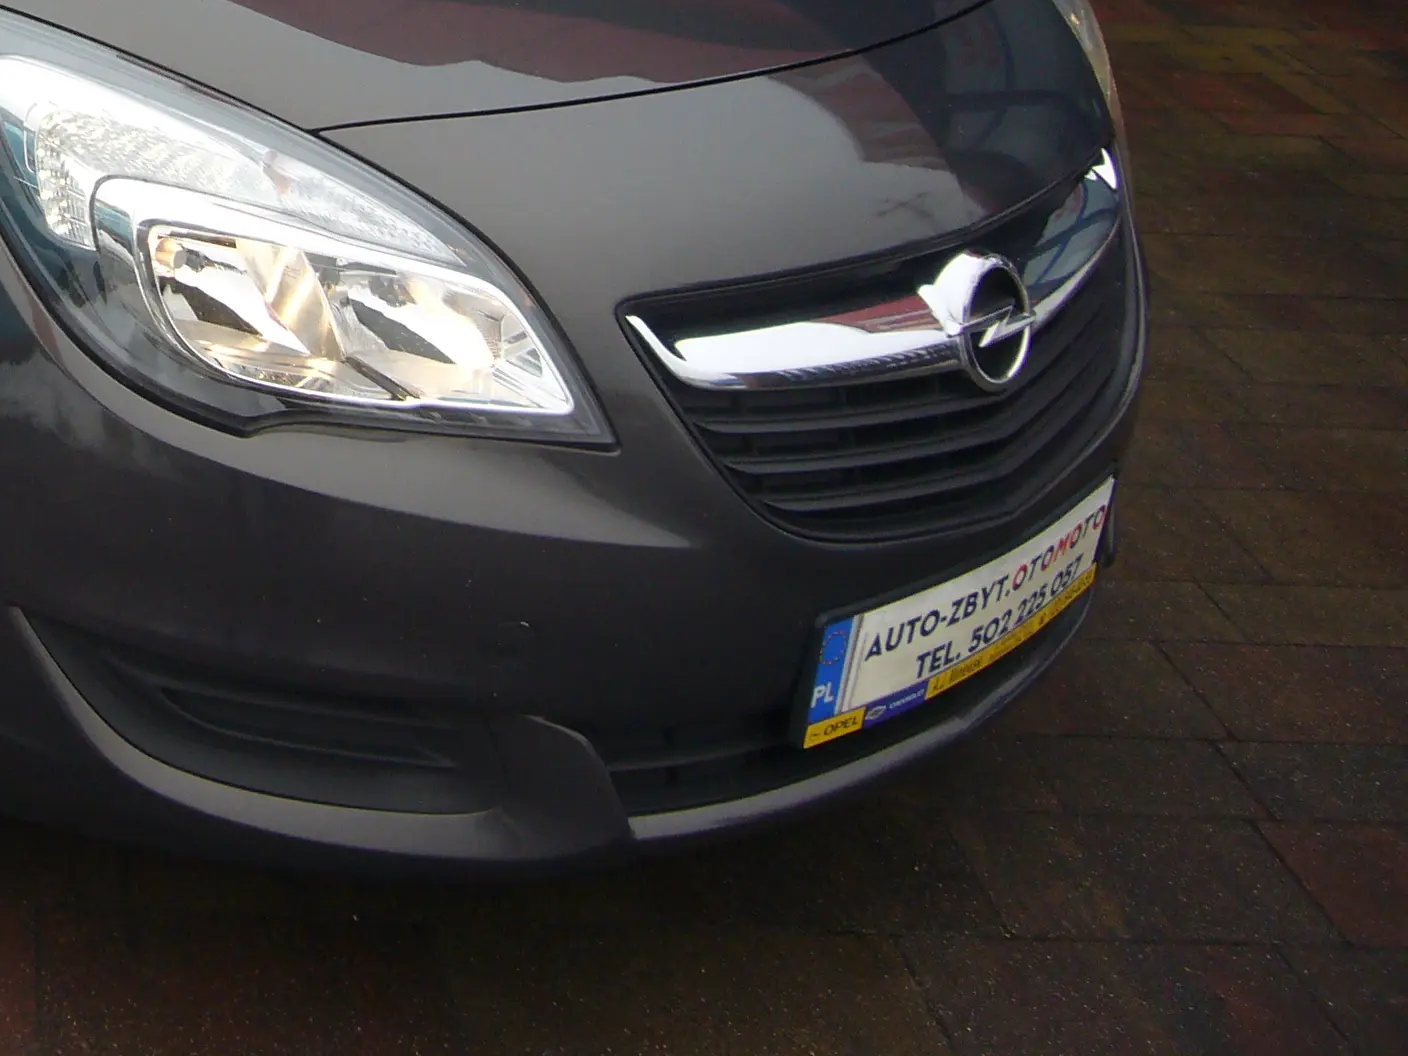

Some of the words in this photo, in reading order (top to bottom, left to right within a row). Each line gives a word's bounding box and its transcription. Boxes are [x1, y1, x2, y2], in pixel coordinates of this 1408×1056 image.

[916, 641, 961, 680] TEL.
[967, 608, 1013, 653] 502
[1013, 583, 1049, 629] 225
[1050, 552, 1084, 597] 057
[811, 682, 834, 709] PL
[824, 716, 858, 736] OPEL
